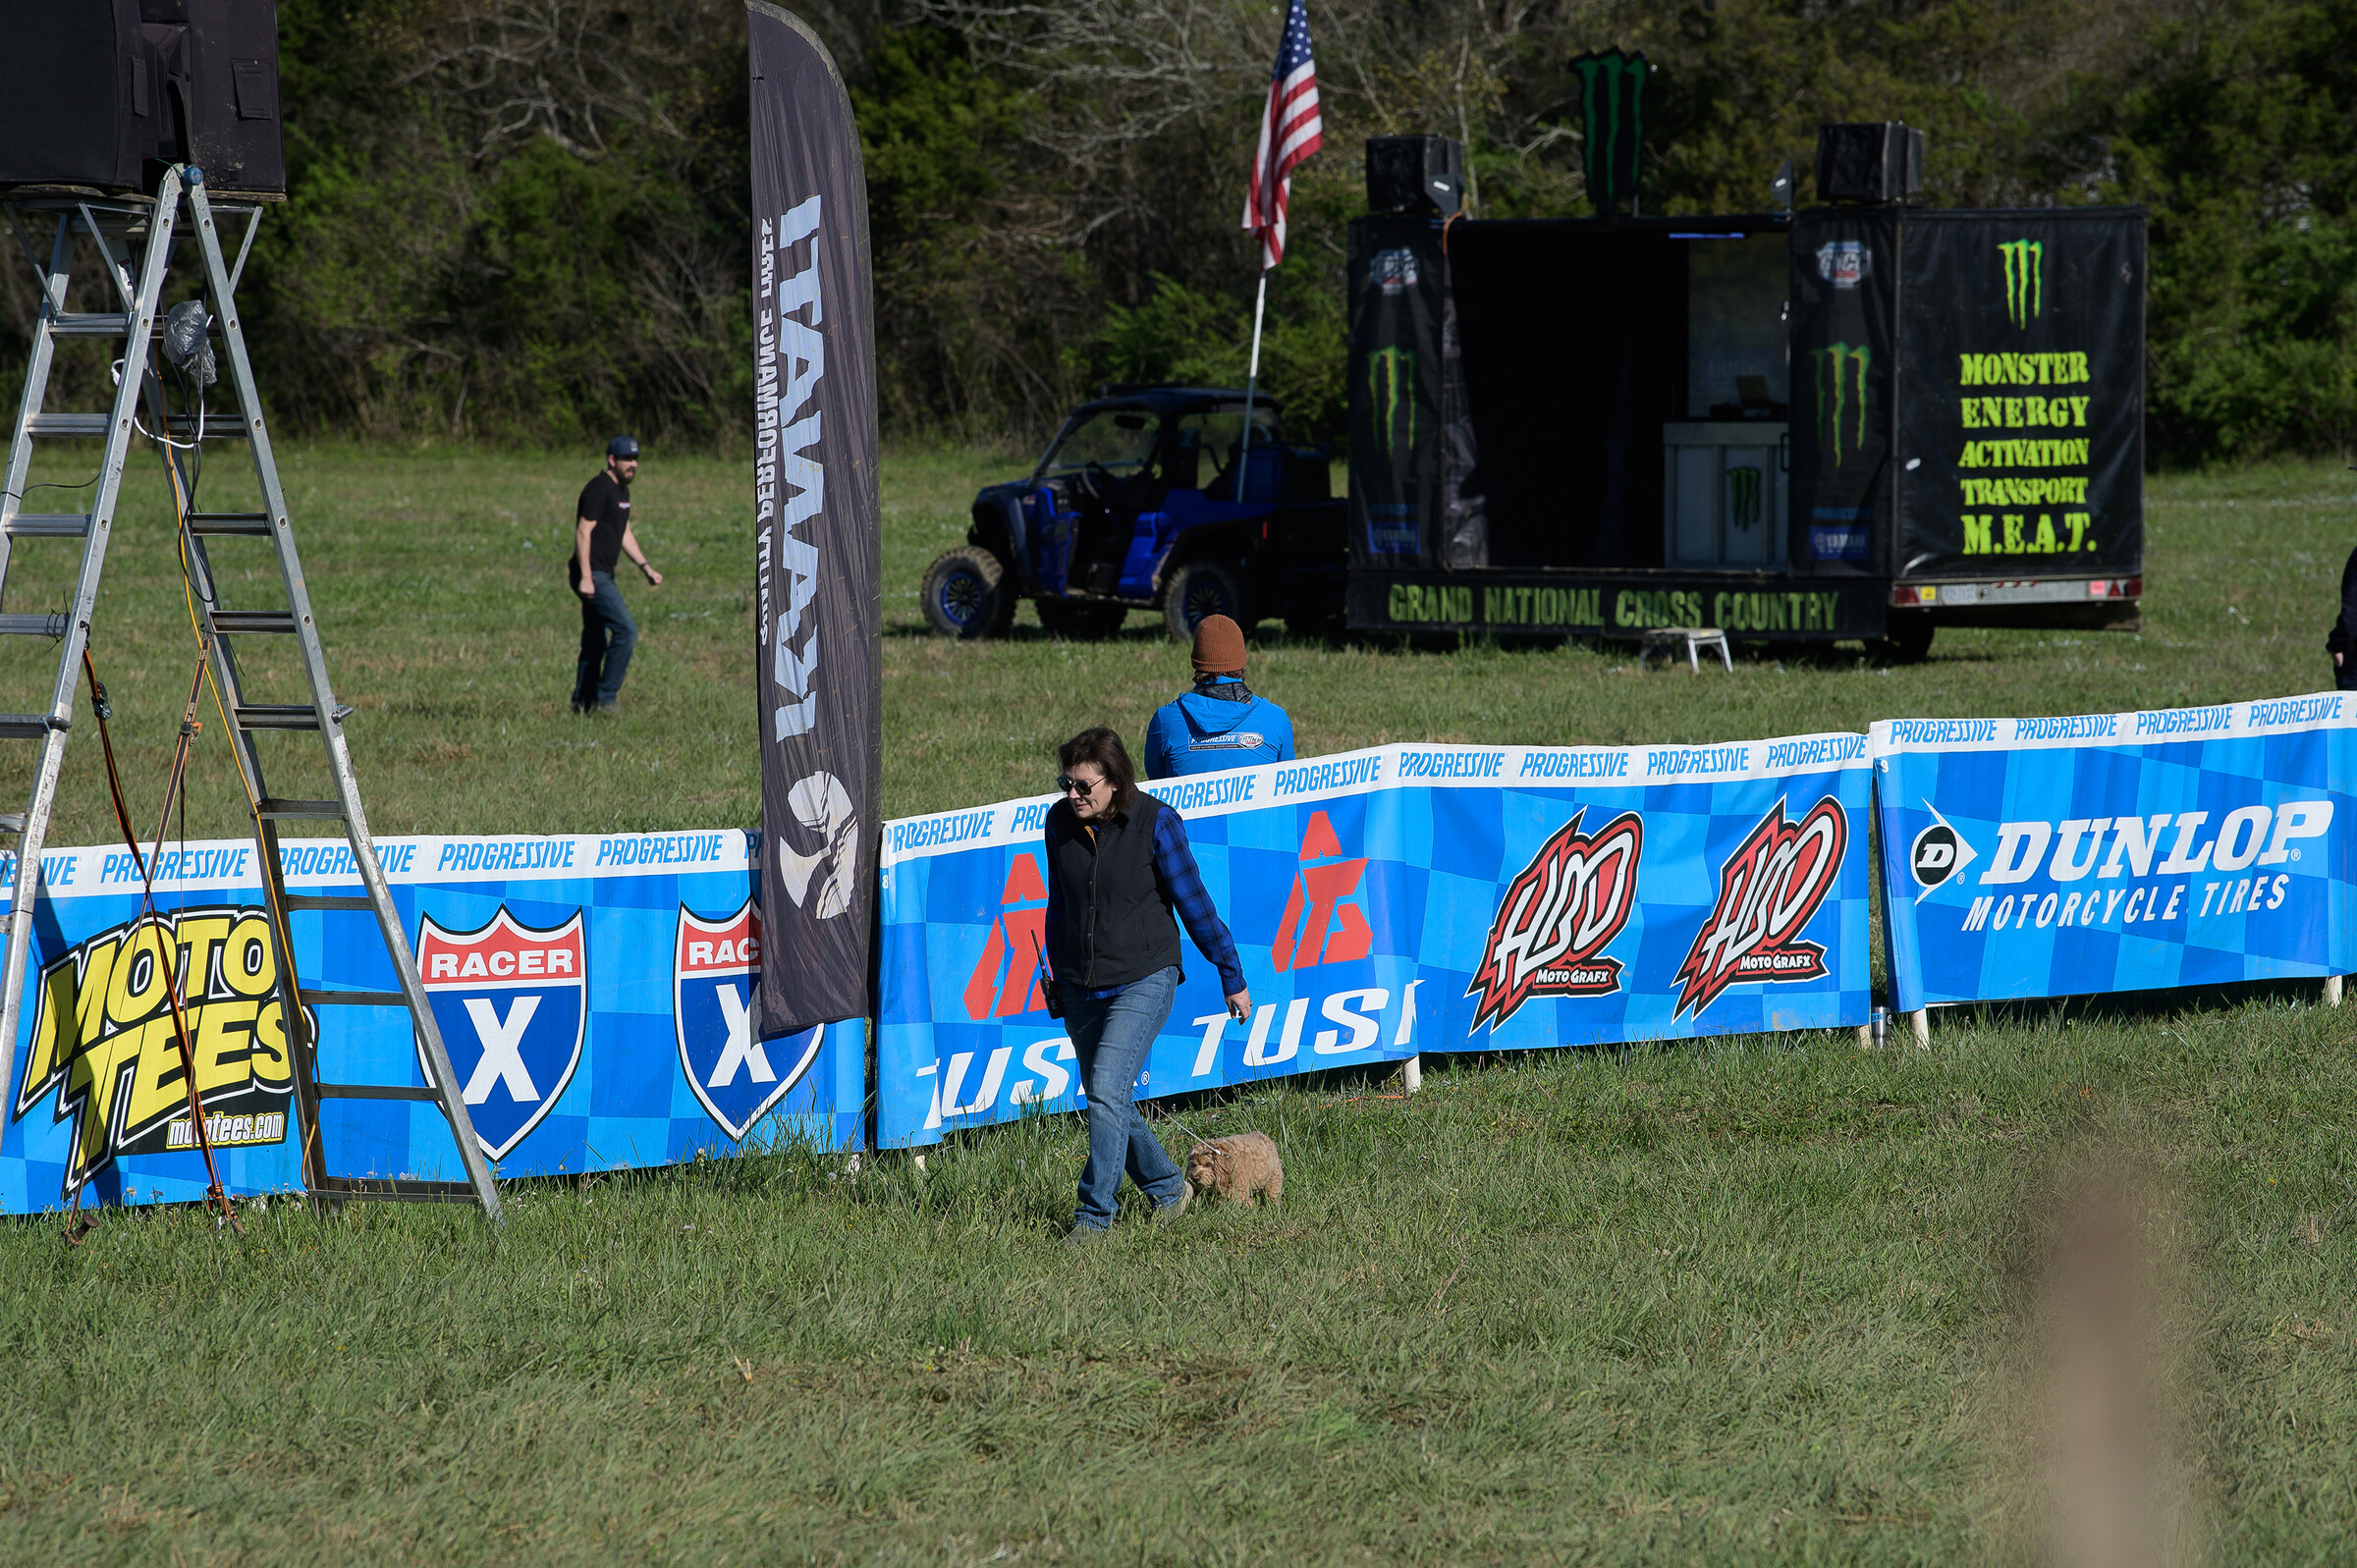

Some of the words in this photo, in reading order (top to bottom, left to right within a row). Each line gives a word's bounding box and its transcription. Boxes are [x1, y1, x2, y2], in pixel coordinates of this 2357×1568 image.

[1959, 351, 2091, 386] MONSTER
[1960, 396, 2091, 428] ENERGY
[1957, 438, 2090, 467] ACTIVATION
[1960, 476, 2089, 506] TRANSPORT
[1960, 512, 2098, 555] M.E.A.T.
[1389, 583, 1473, 622] GRAND
[1484, 586, 1605, 626] NATIONAL
[1615, 590, 1704, 628] CROSS
[1714, 591, 1839, 630] COUNTRY
[1889, 720, 1998, 745] PROGRESSIVE
[2014, 715, 2117, 740] PROGRESSIVE
[2135, 706, 2233, 735] PROGRESSIVE
[2248, 696, 2343, 728] PROGRESSIVE
[1274, 756, 1382, 796] PROGRESSIVE
[1398, 752, 1506, 778] PROGRESSIVE
[1520, 752, 1629, 778] PROGRESSIVE
[1647, 747, 1749, 776] PROGRESSIVE
[1765, 734, 1868, 768] PROGRESSIVE
[279, 844, 416, 875] PROGREIVE
[437, 840, 576, 872] PROGRESSIVE
[595, 835, 723, 866] PROGRESSIVE
[1917, 842, 1956, 869] D
[1979, 800, 2334, 885] DUNLOP
[1961, 885, 2186, 931] MOTORCYCLE
[2200, 874, 2289, 917] TIRES
[431, 948, 574, 979] RACER
[688, 938, 761, 965] RAC
[27, 918, 277, 1095] MOTO
[462, 996, 542, 1106] X
[707, 983, 778, 1088] X
[68, 1000, 292, 1171] TEES
[915, 1037, 1086, 1130] TUS
[168, 1113, 283, 1146] mootees.com
